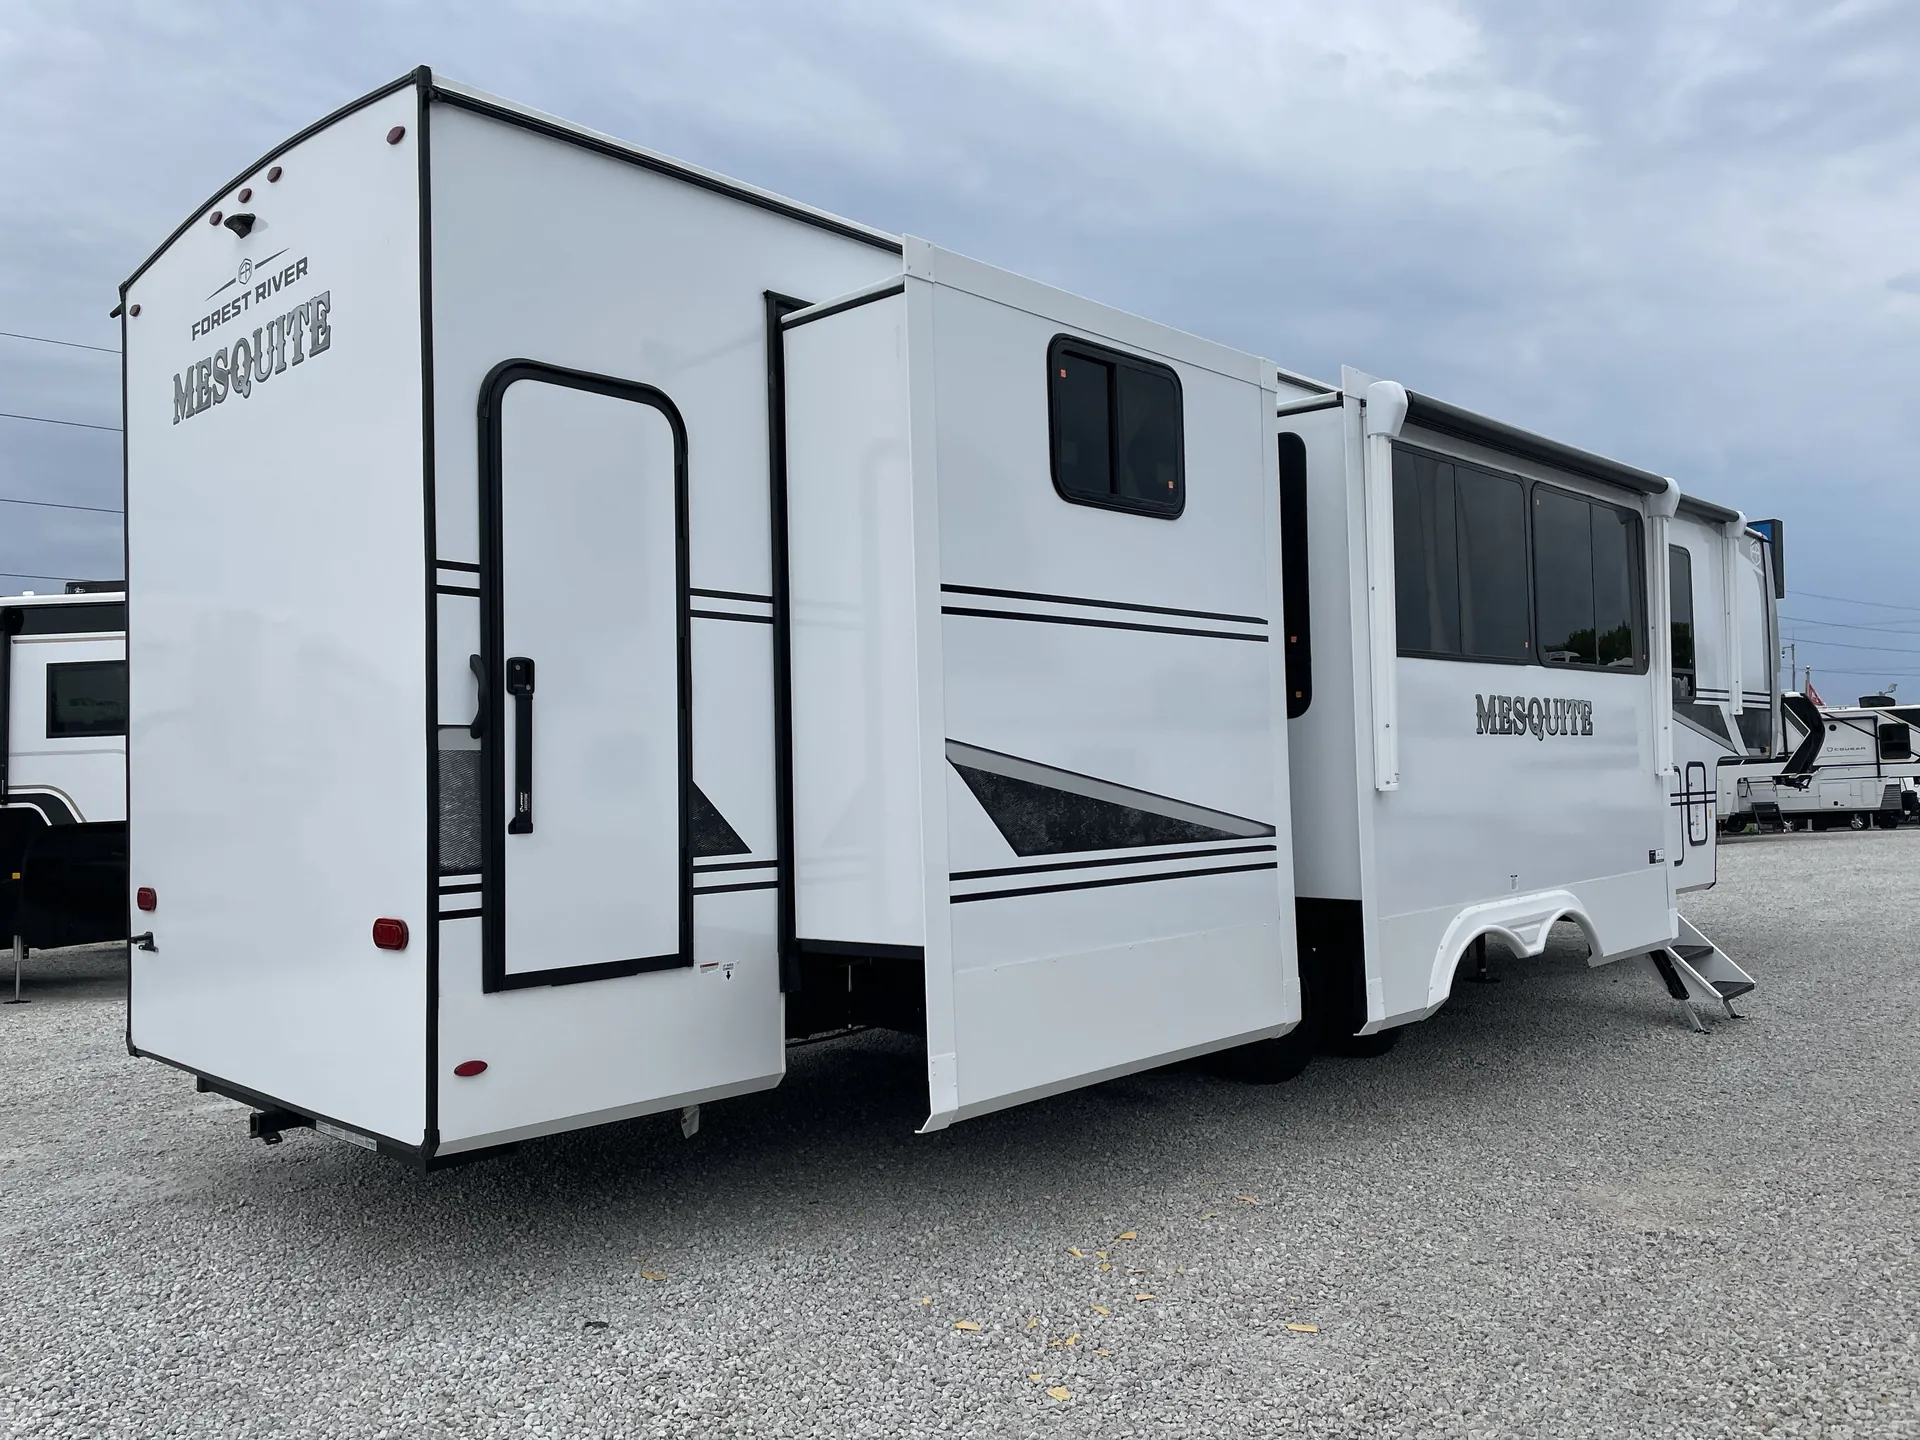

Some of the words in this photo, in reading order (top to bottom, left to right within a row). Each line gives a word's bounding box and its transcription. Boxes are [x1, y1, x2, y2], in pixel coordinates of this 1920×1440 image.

[191, 290, 251, 341] FOREST
[255, 256, 308, 304] RIVER
[173, 290, 331, 425] MESQUITE
[1475, 694, 1593, 741] MESQUITE
